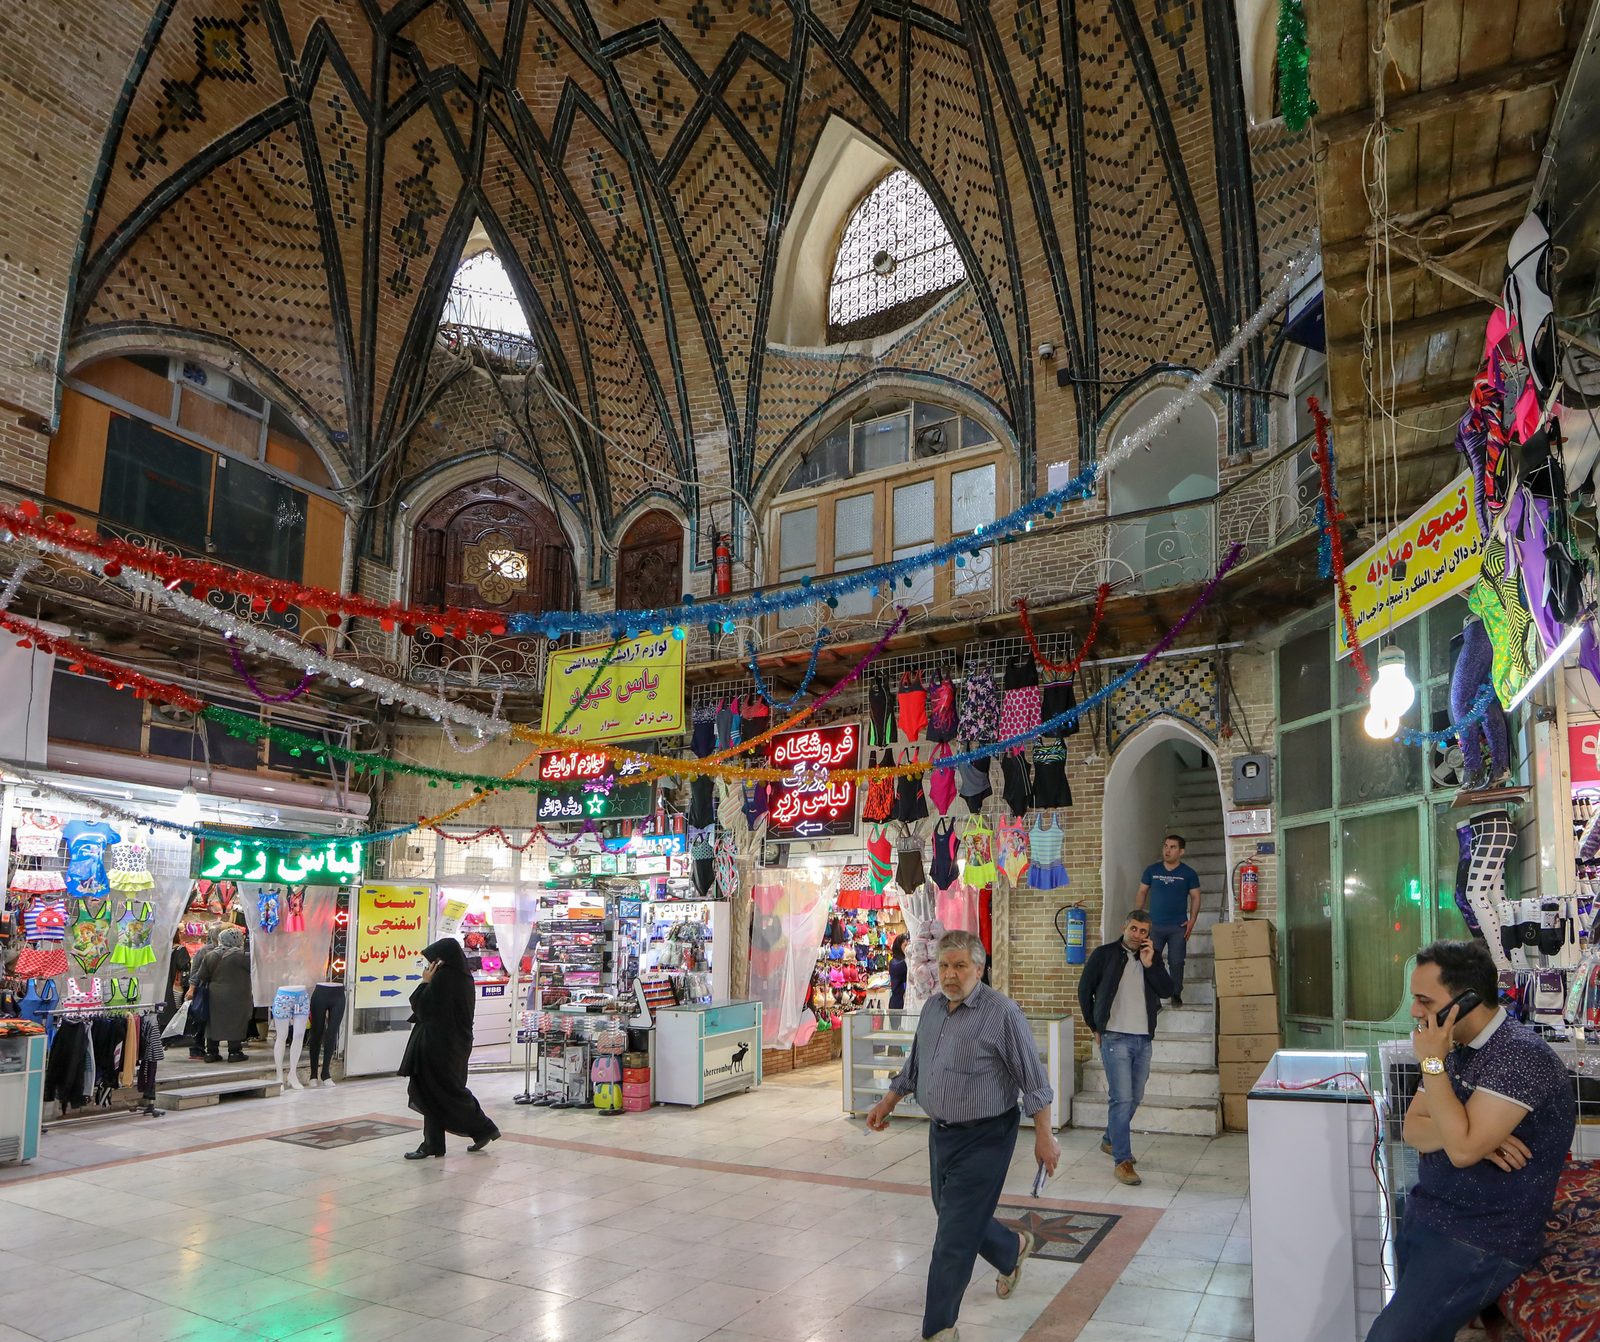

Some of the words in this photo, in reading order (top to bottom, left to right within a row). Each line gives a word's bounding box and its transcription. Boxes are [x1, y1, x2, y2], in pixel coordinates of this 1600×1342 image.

[1416, 486, 1469, 552] تیمچه
[1432, 560, 1448, 584] امین
[1449, 546, 1469, 574] دالان
[1404, 586, 1410, 601] و
[1410, 568, 1431, 594] الملک
[642, 639, 668, 659] لوازم
[564, 657, 599, 675] بهداشتی
[569, 677, 613, 710] کبود
[616, 668, 660, 703] یاس
[774, 726, 853, 764] فروشگاه
[577, 752, 606, 775] لوازم
[772, 790, 801, 823] زیر
[802, 780, 851, 817] لباس
[636, 837, 681, 852] ILIPS
[201, 840, 267, 880] زیر
[277, 840, 363, 884] لباس
[373, 894, 416, 909] ست
[663, 903, 698, 913] CLIVEN
[366, 915, 422, 935] اسفنجی
[359, 944, 390, 964] تومان
